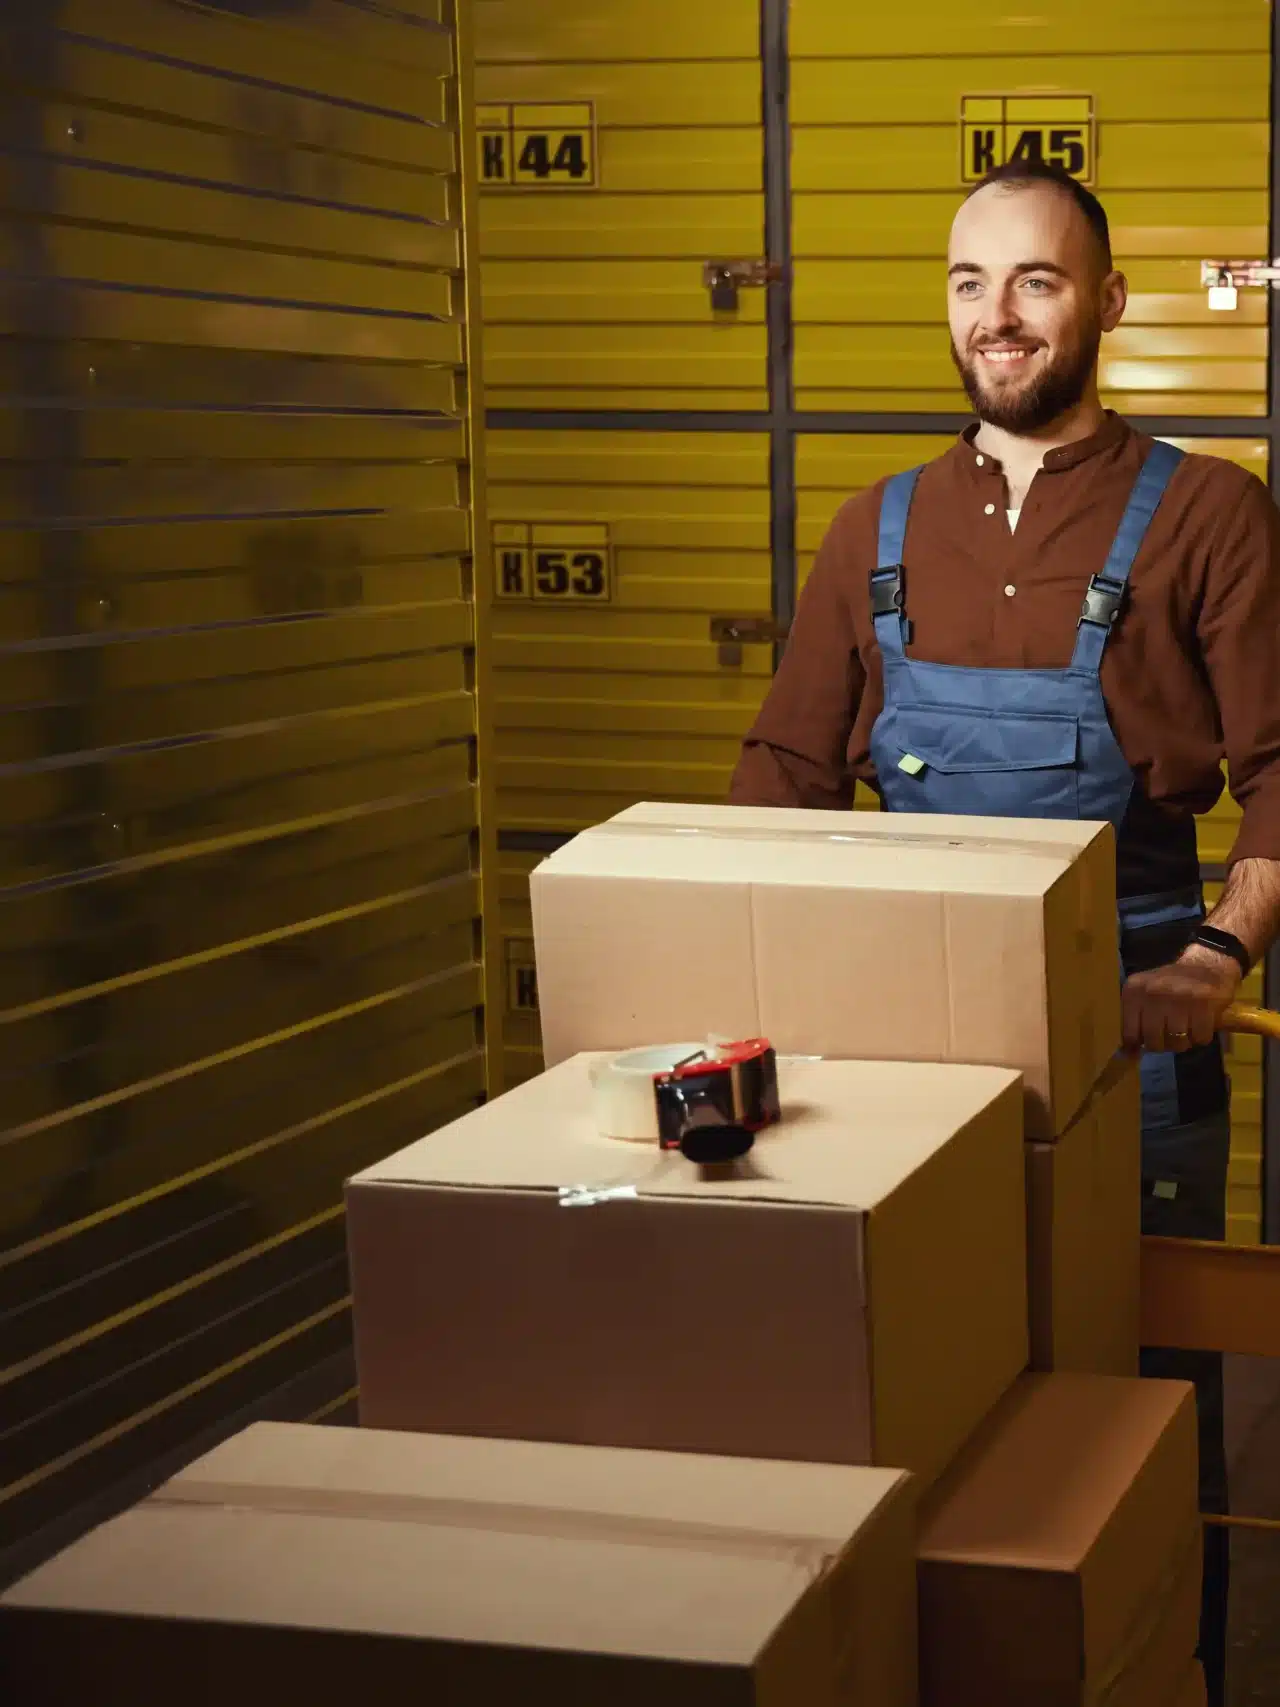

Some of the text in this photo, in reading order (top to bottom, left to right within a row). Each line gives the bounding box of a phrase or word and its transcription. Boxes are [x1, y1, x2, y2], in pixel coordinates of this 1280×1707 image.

[483, 135, 588, 178] K 44
[973, 130, 1084, 174] K 45
[503, 552, 604, 595] K 53
